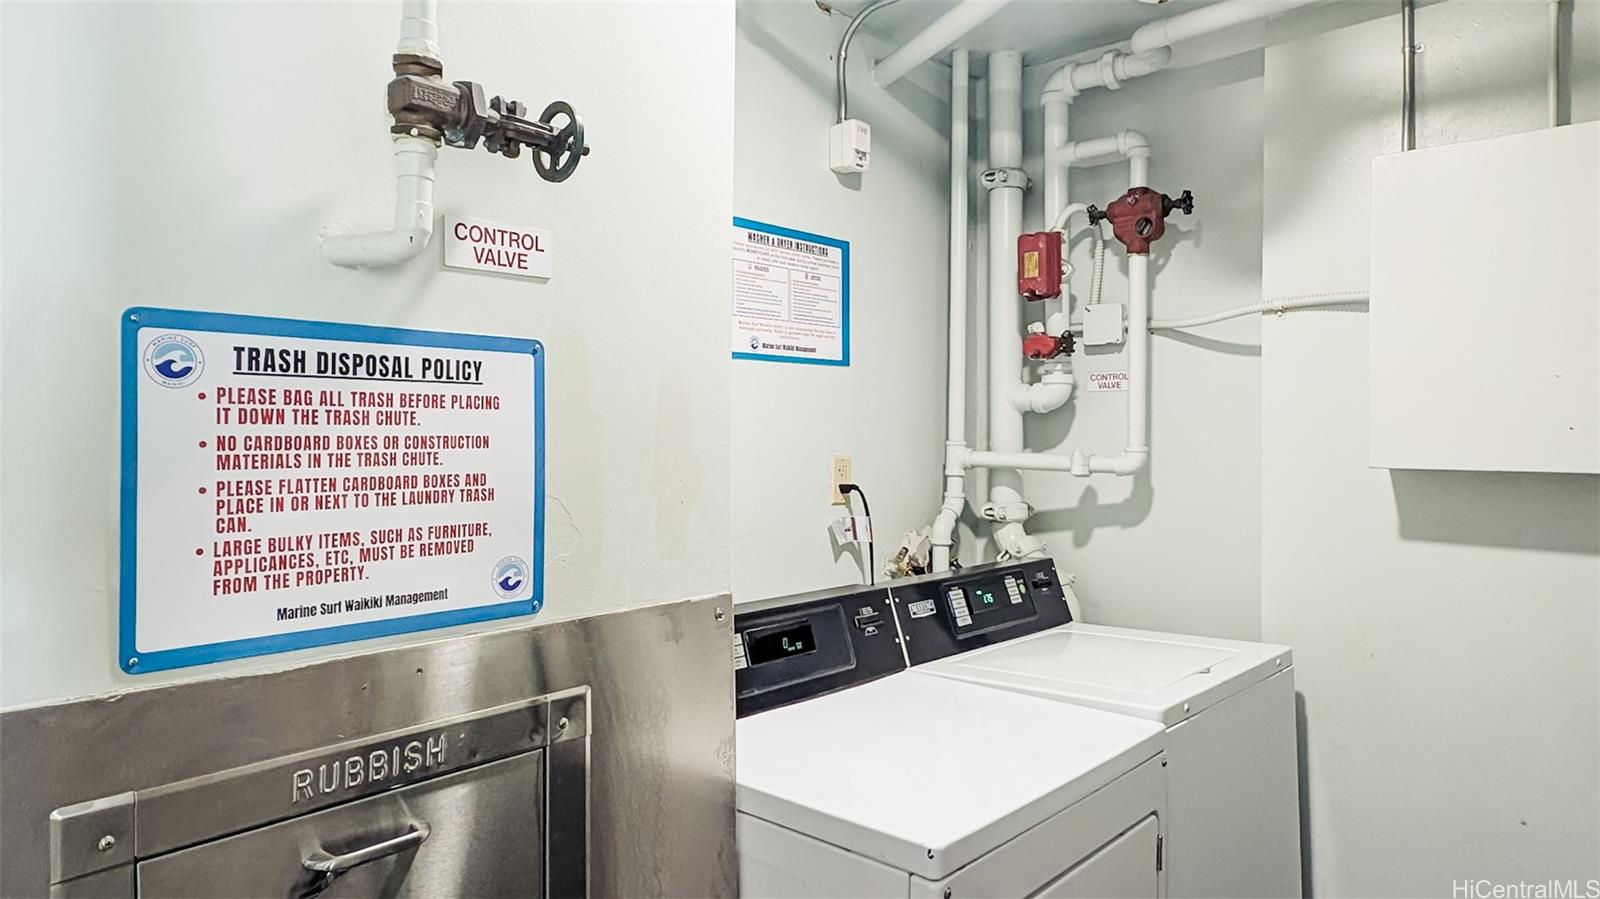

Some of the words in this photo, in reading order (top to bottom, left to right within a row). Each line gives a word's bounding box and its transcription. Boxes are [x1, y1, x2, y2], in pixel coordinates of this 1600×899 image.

[454, 222, 545, 252] CONTROL
[748, 232, 770, 243] WASHER
[777, 238, 793, 250] DRYER
[794, 241, 828, 257] INSTRUCTIONS
[473, 246, 528, 270] VALVE
[233, 346, 306, 373] TRASH
[317, 350, 413, 378] DISPOSAL
[422, 358, 482, 382] POLICY
[1090, 372, 1128, 382] CONTROL
[1098, 382, 1122, 390] VALVE
[217, 388, 276, 406] PLEASE
[284, 390, 312, 406] BAG
[320, 390, 344, 408] ALL
[350, 392, 394, 408] TRASH
[400, 393, 446, 409] BEFORE
[452, 395, 500, 410] PLACING
[217, 408, 230, 424] IT
[238, 408, 285, 425] DOWN
[292, 409, 319, 425] THE
[326, 410, 370, 426] TRASH
[376, 410, 420, 426] CHUTE.
[217, 436, 236, 452] NO
[244, 436, 330, 452] CARDBOARD
[336, 436, 378, 450] BOXES
[384, 436, 399, 450] OR
[404, 436, 490, 450] CONSTRUCTION
[217, 454, 301, 470] MATERIALS
[308, 454, 320, 468] IN
[328, 453, 351, 468] THE
[357, 452, 397, 467] TRASH
[402, 452, 443, 466] CHUTE.
[217, 480, 272, 497] PLEASE
[279, 477, 336, 496] FLATTEN
[343, 475, 418, 492] CARDBOARD
[424, 474, 460, 488] BOXES
[465, 473, 487, 487] AND
[217, 498, 263, 516] PLACE
[270, 496, 284, 512] IN
[291, 496, 309, 512] OR
[316, 494, 348, 510] NEXT
[354, 493, 368, 508] TO
[375, 492, 397, 507] THE
[402, 490, 456, 506] LAUNDRY
[460, 488, 495, 503] TRASH
[216, 516, 252, 534] CAN.
[214, 538, 262, 558] LARGE
[268, 534, 313, 553] BULKY
[319, 532, 364, 550] ITEMS,
[370, 528, 402, 546] SUCH
[408, 527, 423, 542] AS
[428, 522, 492, 540] FURNITURE,
[213, 552, 320, 576] APPLICANCES,
[326, 550, 353, 566] ETC,
[359, 546, 395, 563] MUST
[400, 544, 414, 559] BE
[420, 539, 474, 557] REMOVED
[213, 576, 257, 596] FROM
[264, 574, 290, 590] THE
[296, 566, 369, 588] PROPERTY.
[276, 604, 317, 620] Marine
[320, 600, 342, 616] Surf
[345, 596, 383, 612] Waikiki
[386, 588, 448, 610] Management
[292, 733, 447, 803] RUBBISH
